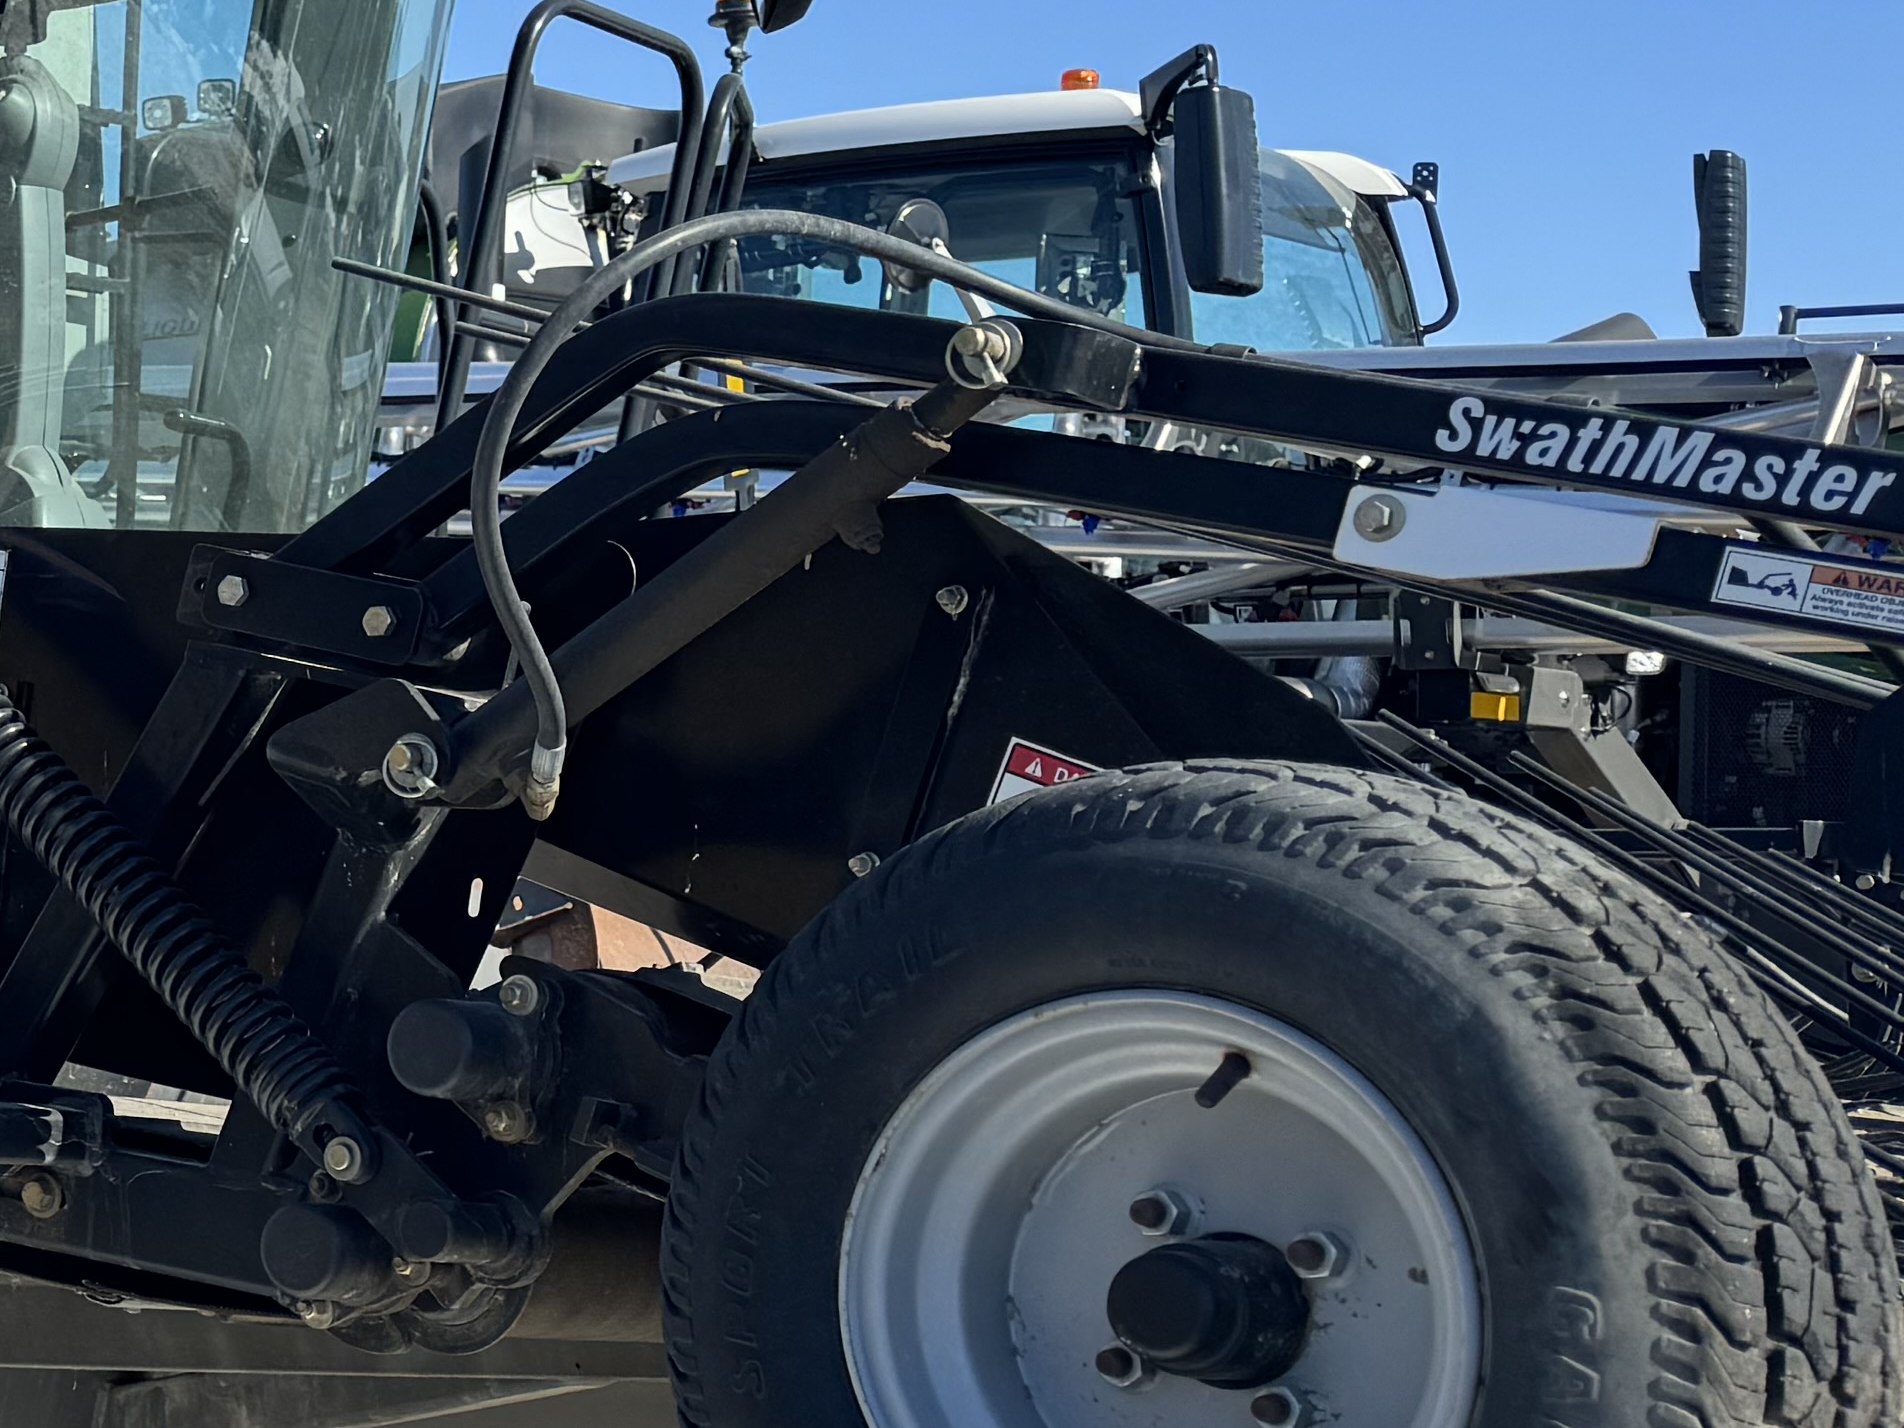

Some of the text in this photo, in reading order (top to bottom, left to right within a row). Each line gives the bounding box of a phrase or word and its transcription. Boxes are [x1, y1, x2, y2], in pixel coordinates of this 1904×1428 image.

[1435, 396, 1898, 516] SwathMaster
[1810, 594, 1844, 606] Always
[1847, 601, 1885, 613] activate
[1822, 587, 1878, 603] OVERHEAD
[1812, 604, 1849, 616] working
[1851, 610, 1880, 620] under
